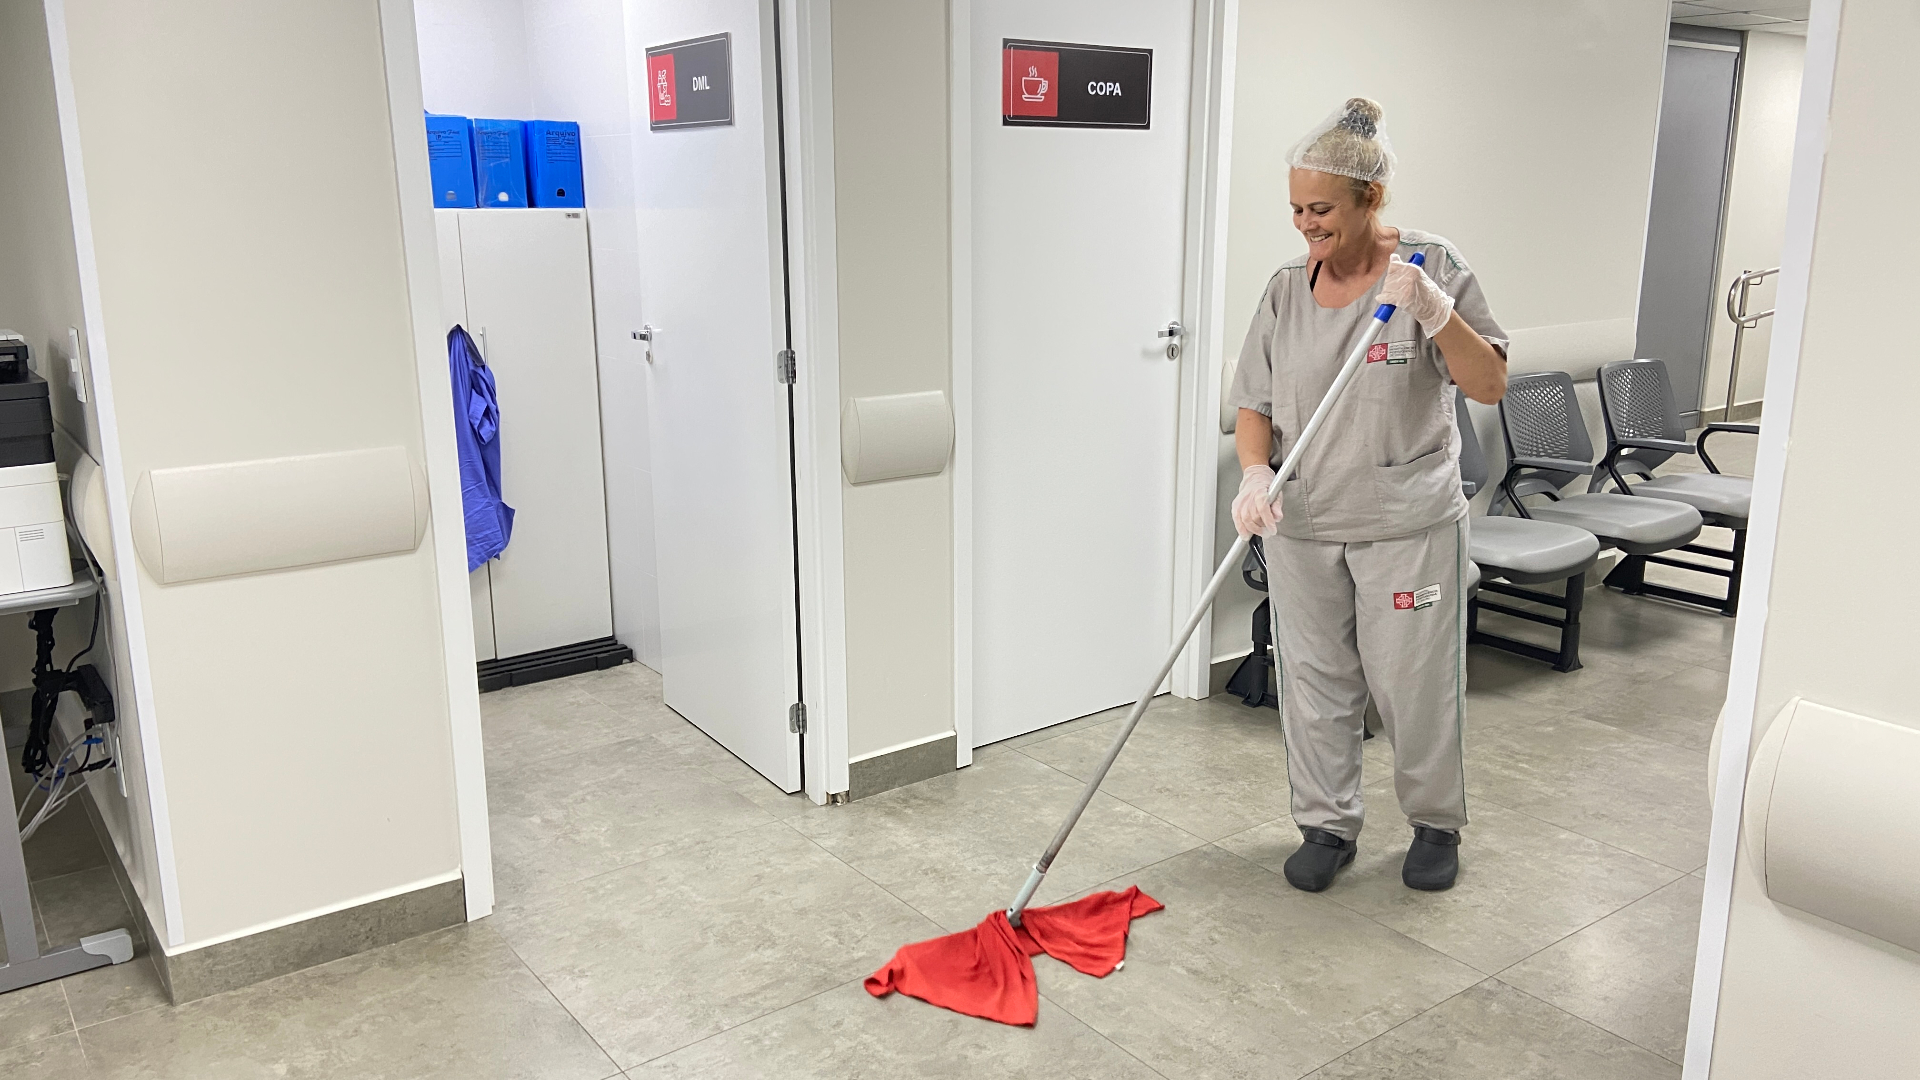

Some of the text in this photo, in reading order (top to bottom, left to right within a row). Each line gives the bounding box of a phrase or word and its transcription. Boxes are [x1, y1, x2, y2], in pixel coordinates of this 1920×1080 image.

[693, 75, 710, 91] DML
[1087, 81, 1122, 96] COPA
[546, 130, 576, 138] Arquivo
